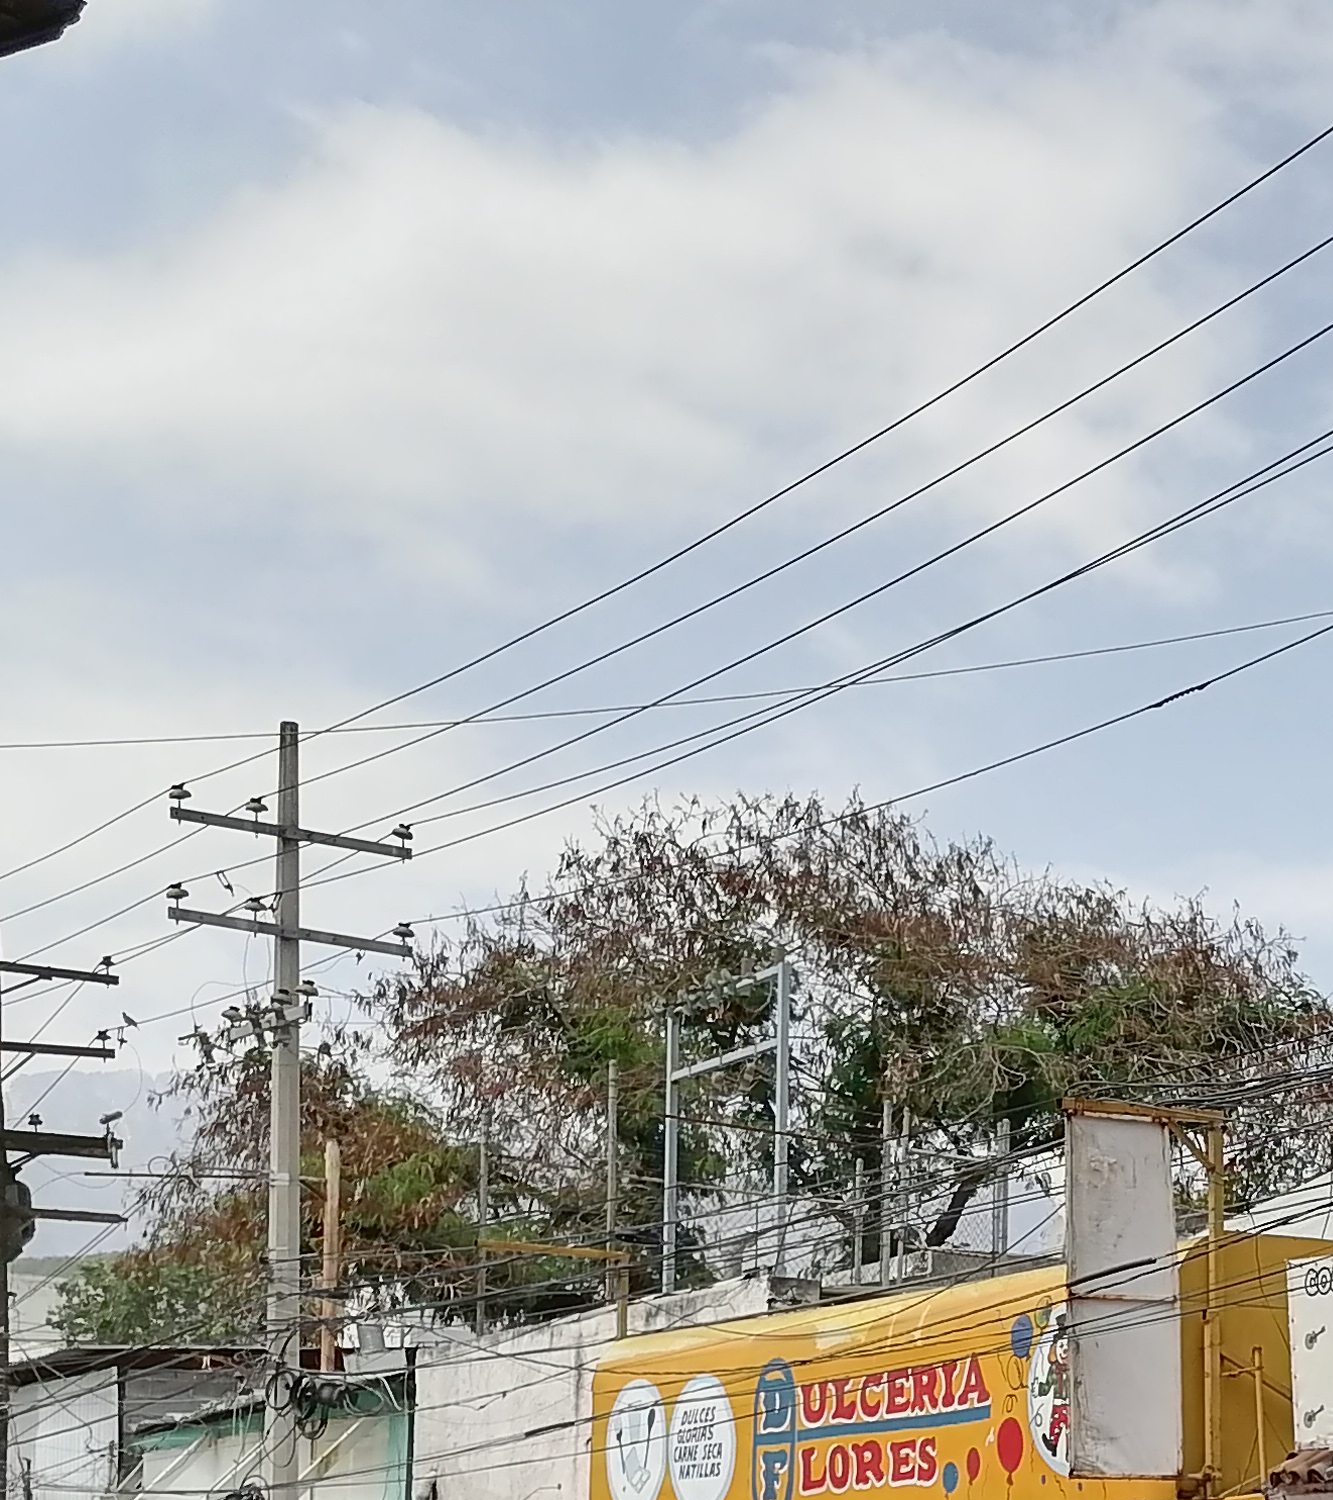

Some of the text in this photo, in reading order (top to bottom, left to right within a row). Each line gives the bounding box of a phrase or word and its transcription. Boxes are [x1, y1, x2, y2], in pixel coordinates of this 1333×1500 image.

[681, 1406, 716, 1426] DULCES
[677, 1424, 714, 1444] GLORIAS
[674, 1443, 722, 1463] CARNE SECA
[679, 1462, 721, 1480] NATILLAS
